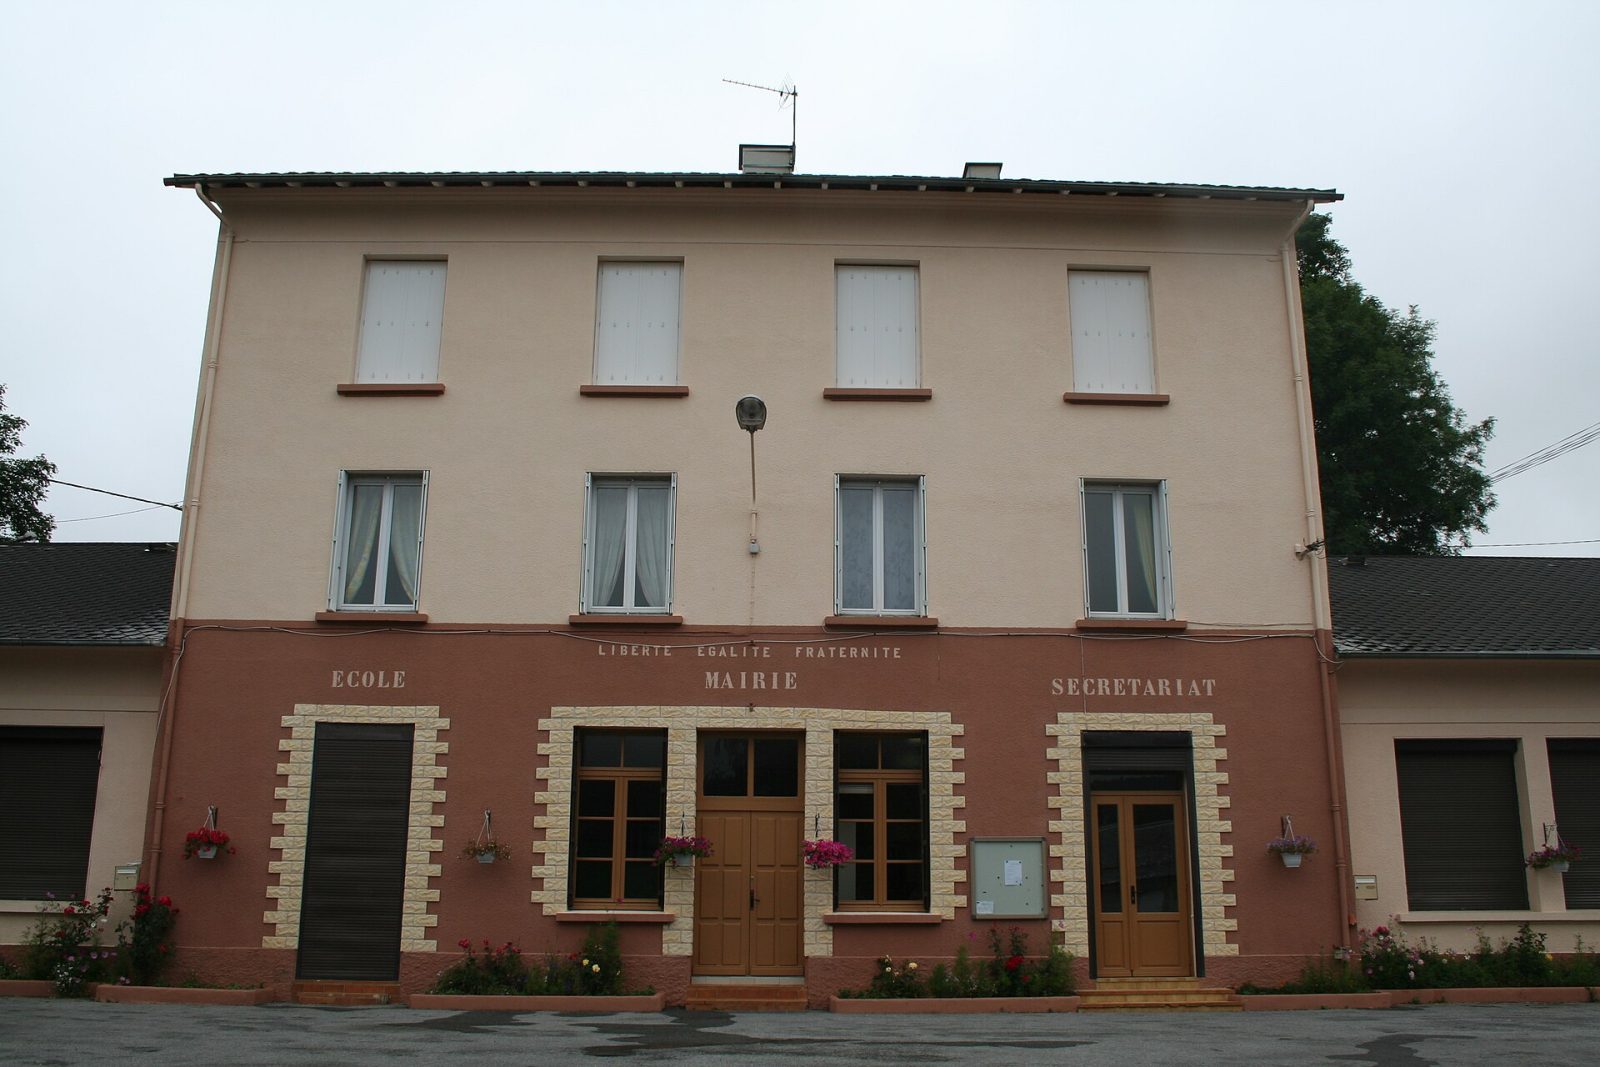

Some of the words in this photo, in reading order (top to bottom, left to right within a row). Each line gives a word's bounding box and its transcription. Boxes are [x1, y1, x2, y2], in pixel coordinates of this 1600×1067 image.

[598, 644, 672, 657] LIBERTE
[697, 646, 771, 658] EGALITE
[795, 646, 901, 659] FRATERNITE
[332, 670, 406, 688] ECOLE
[704, 671, 798, 690] MAIRIE
[1051, 677, 1216, 696] SECRETARIAT
